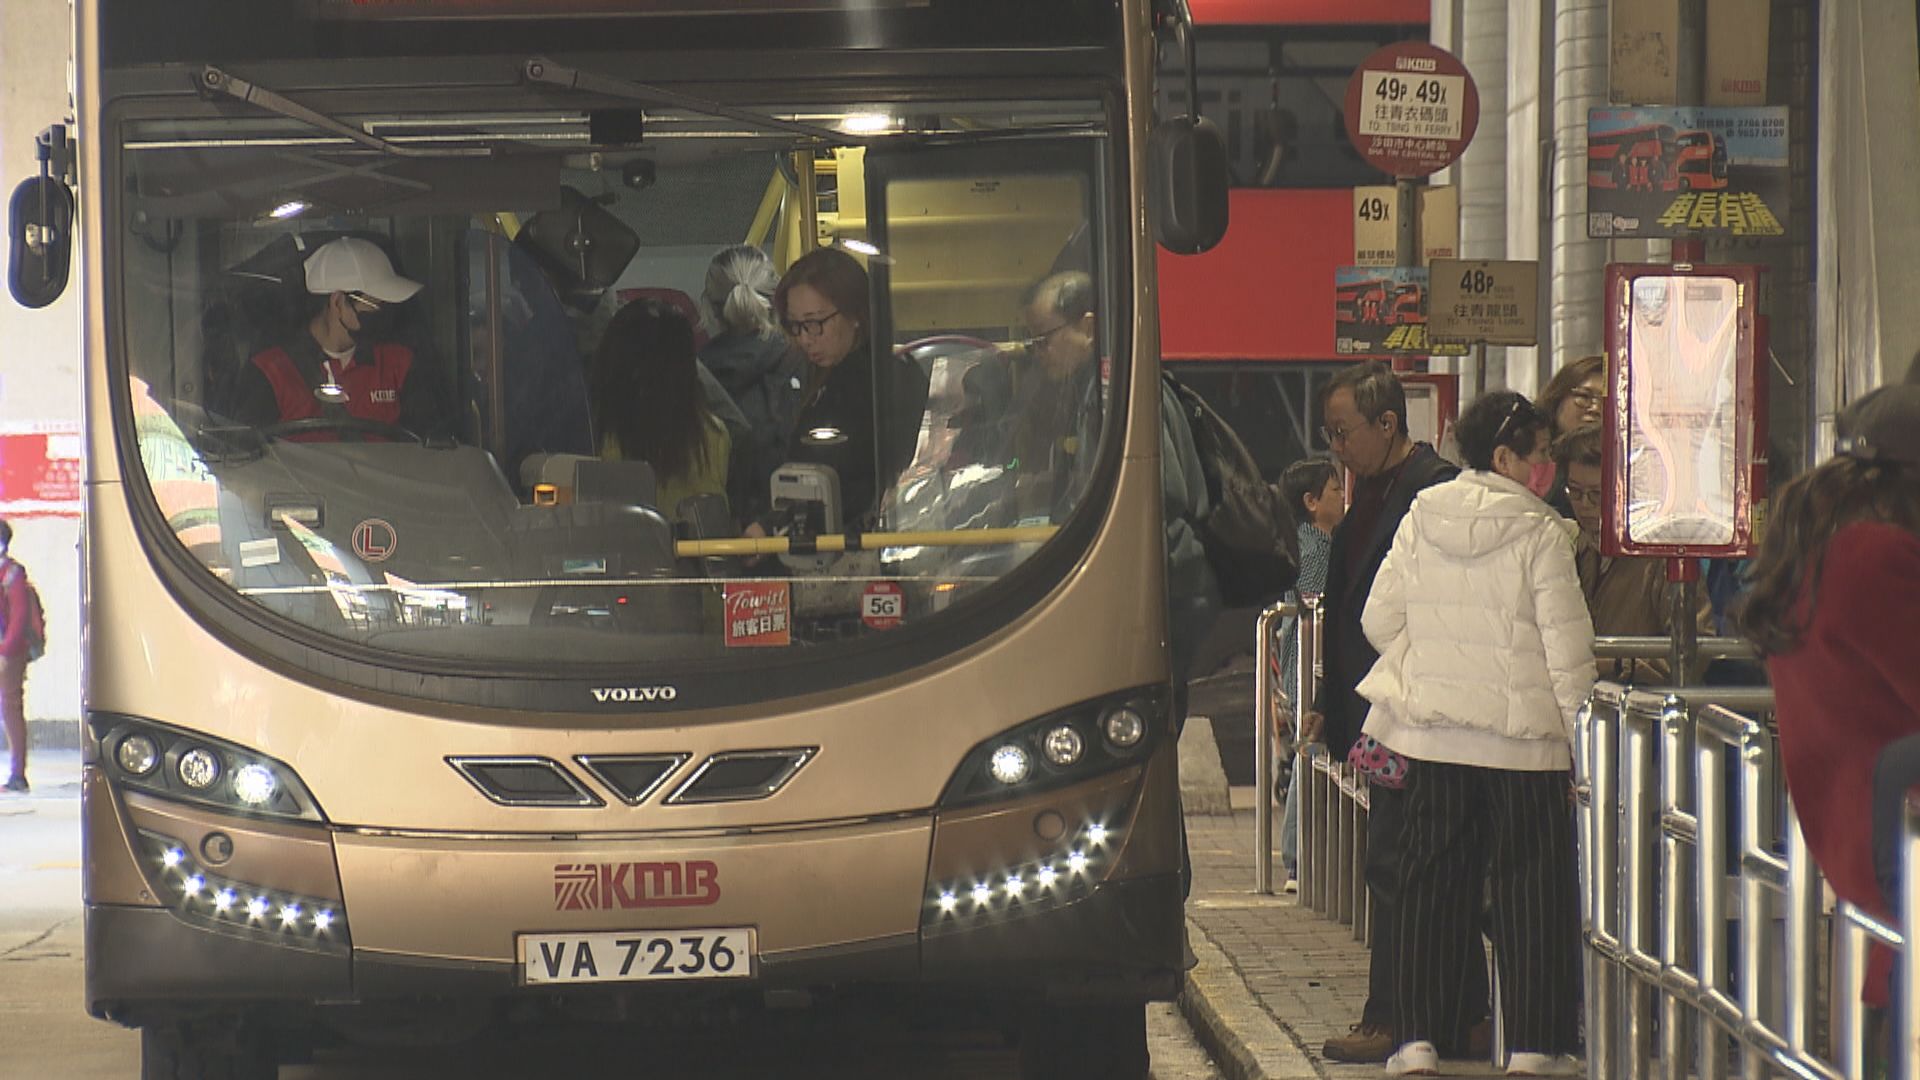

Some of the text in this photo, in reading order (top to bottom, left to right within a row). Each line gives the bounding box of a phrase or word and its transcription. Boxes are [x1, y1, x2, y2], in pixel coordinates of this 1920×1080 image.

[1408, 58, 1436, 71] KMB
[1415, 80, 1447, 104] 49X
[1375, 103, 1449, 123] 往青衣碼頭
[1368, 120, 1380, 132] TO
[1424, 124, 1452, 135] FERRY
[1358, 197, 1390, 221] 49X
[1459, 269, 1495, 294] 48P
[1381, 324, 1429, 350] 車長
[726, 588, 785, 616] Tourist
[732, 613, 787, 639] 旅客日票
[590, 685, 677, 702] VOLVO
[601, 860, 721, 910] KMB
[539, 935, 736, 977] VA 7236
